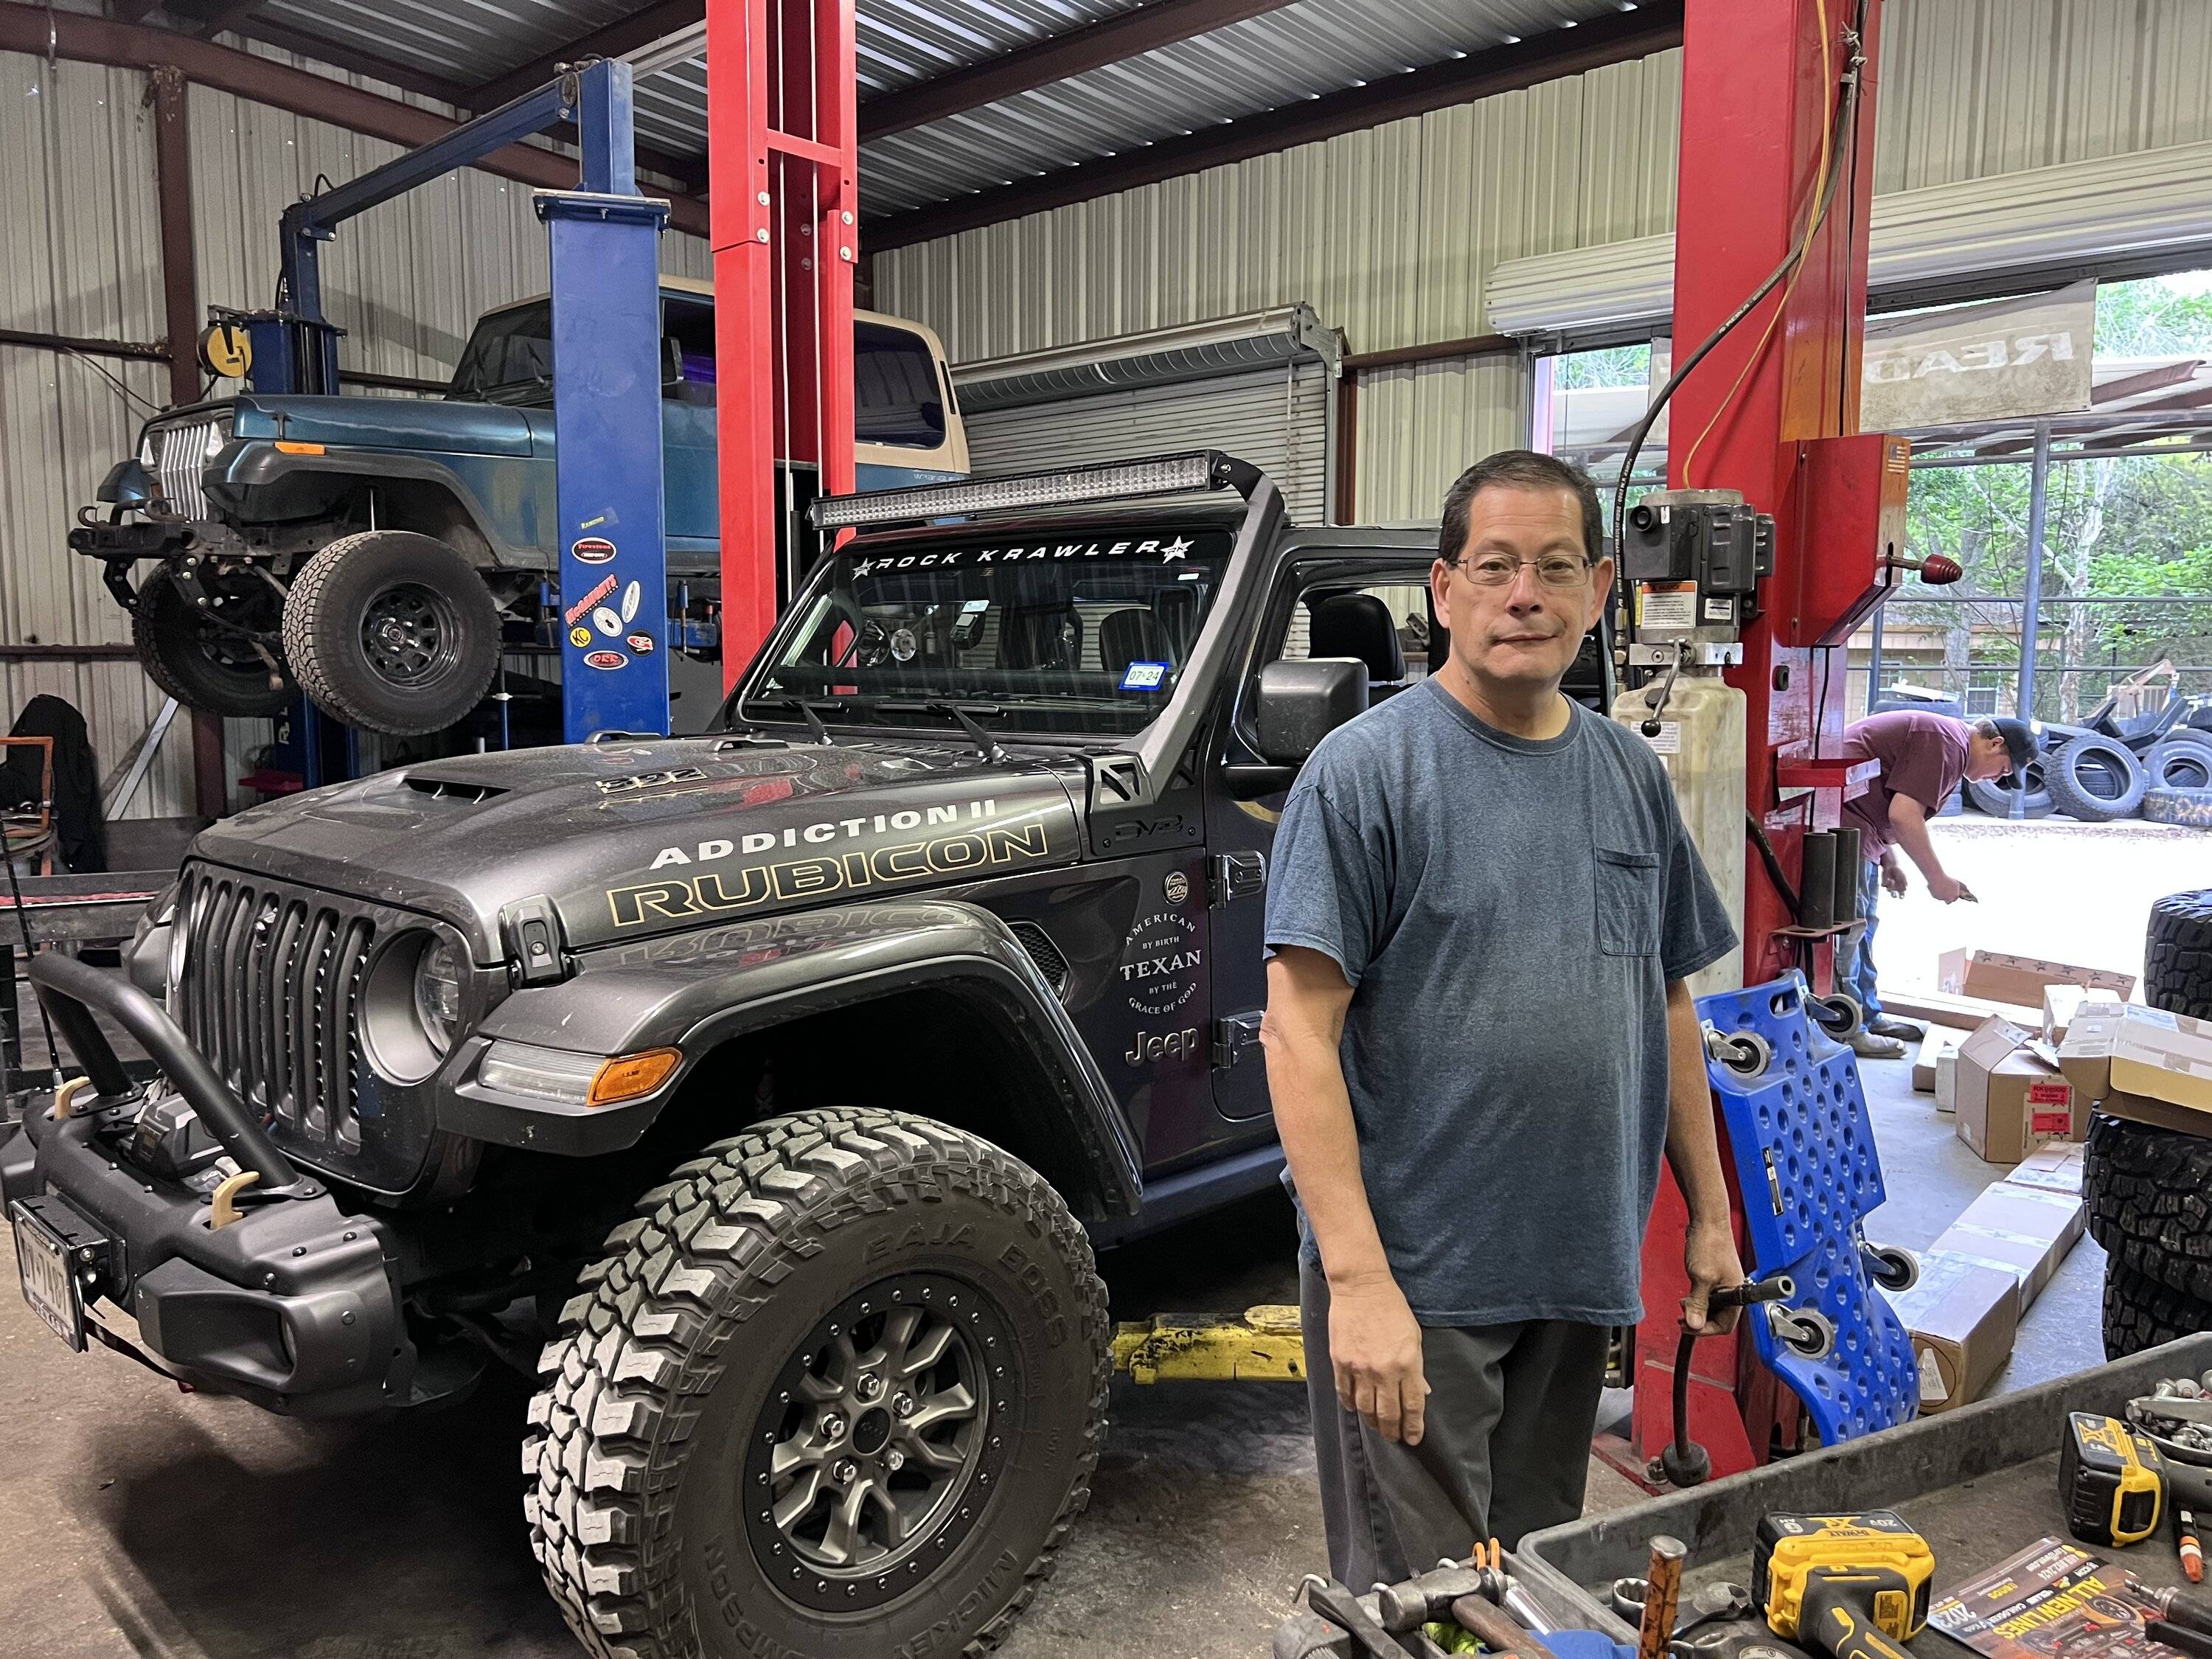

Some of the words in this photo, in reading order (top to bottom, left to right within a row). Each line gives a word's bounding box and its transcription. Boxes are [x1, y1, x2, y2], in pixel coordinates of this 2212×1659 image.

[875, 552, 962, 569] ROCK
[976, 540, 1161, 562] KRAWLER
[572, 629, 589, 645] KC
[1129, 671, 1143, 681] 07
[1146, 671, 1160, 681] 24
[648, 804, 958, 870] ADDICTION
[970, 799, 996, 818] II
[606, 824, 1049, 927] RUBICON
[1125, 913, 1195, 946] AMERICAN
[1143, 941, 1152, 950] BY
[1155, 936, 1180, 947] BIRTH
[1119, 950, 1202, 981] TEXAN
[1129, 997, 1161, 1015] GRACE
[1163, 1001, 1176, 1013] OF
[1178, 982, 1197, 1004] GOD
[1149, 986, 1160, 995] BY
[1161, 981, 1178, 991] THE
[1125, 1028, 1200, 1068] Jeep
[1869, 1519, 1898, 1527] 20V
[2067, 1576, 2107, 1599] ALL
[1935, 1602, 1977, 1628] 2023
[2037, 1592, 2082, 1620] NEW
[1992, 1611, 2042, 1640] LINES
